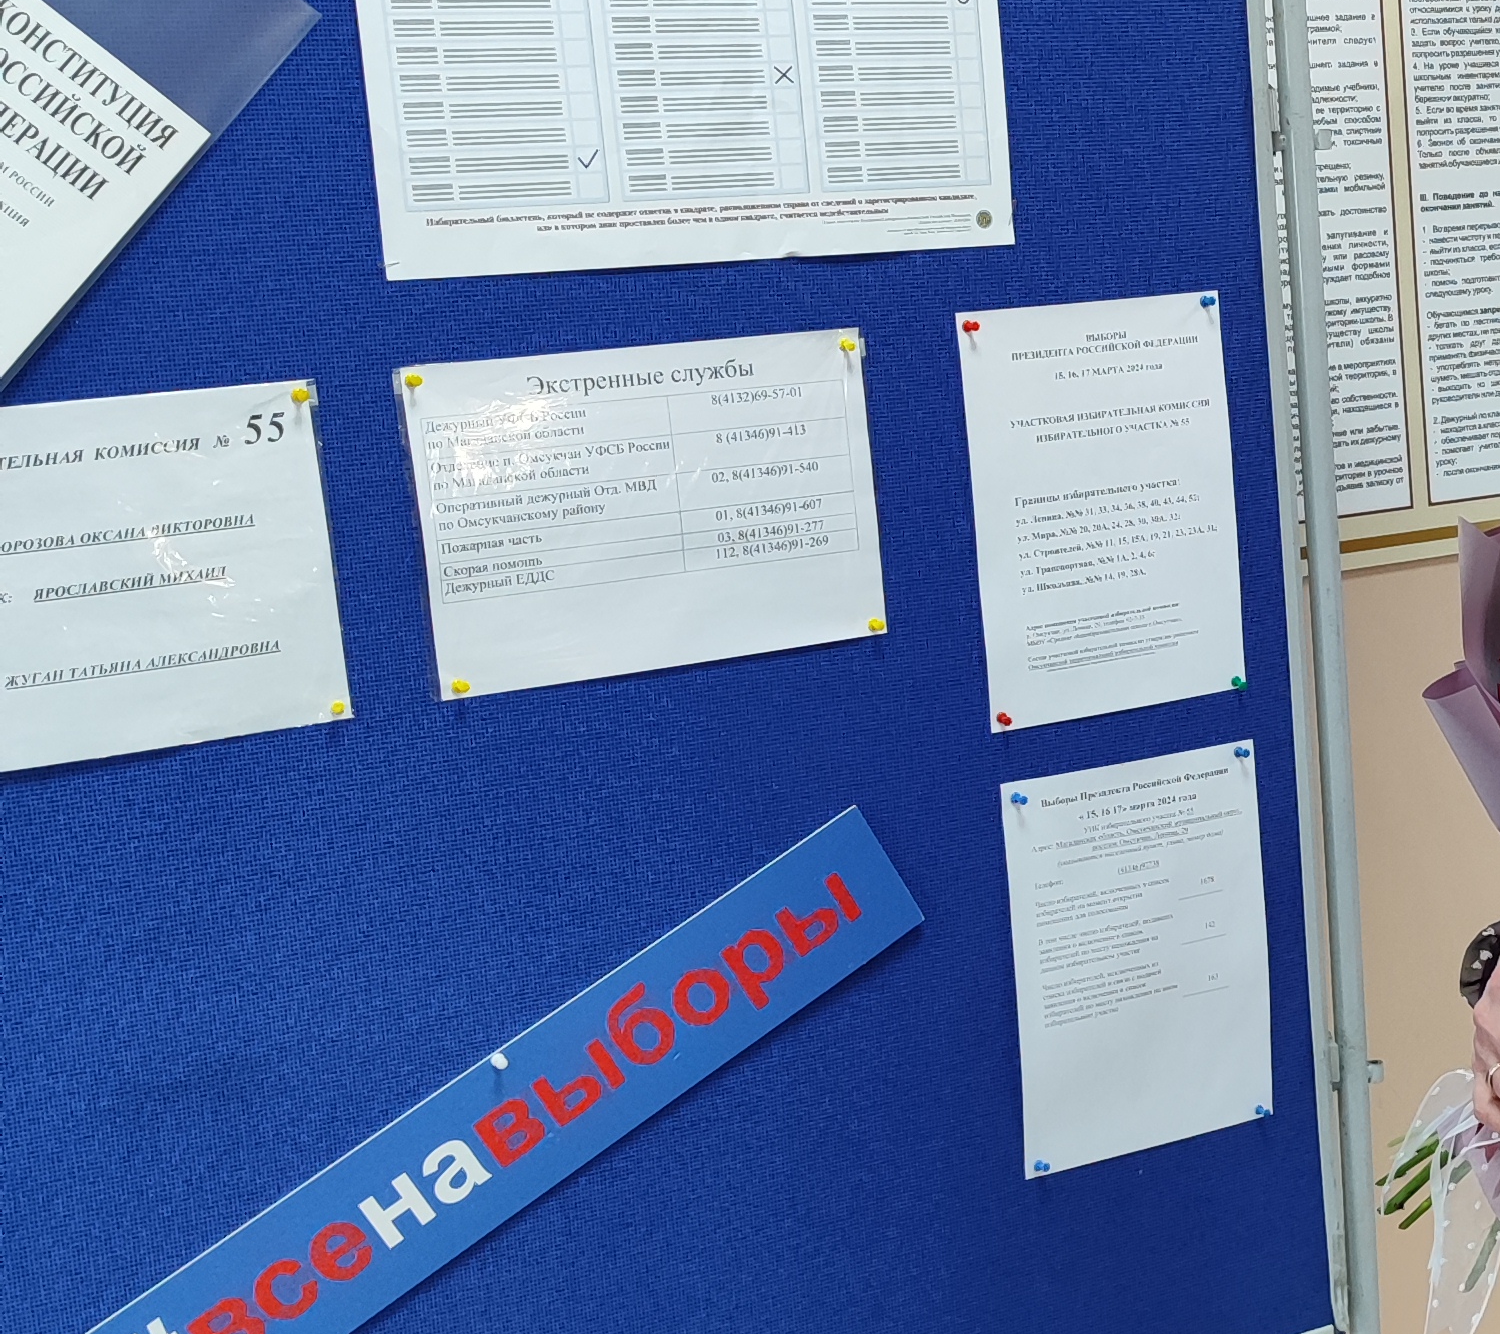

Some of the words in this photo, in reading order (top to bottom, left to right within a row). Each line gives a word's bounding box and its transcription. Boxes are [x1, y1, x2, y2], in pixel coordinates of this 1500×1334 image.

[7, 169, 56, 208] РОССИИ
[1076, 339, 1141, 354] РОССИЙСКОЙ
[526, 370, 664, 396] Экстренные
[670, 358, 754, 386] службы
[1091, 365, 1124, 376] МАРТА
[710, 386, 801, 406] 8(4132)69-57-01
[244, 411, 284, 444] 55
[1010, 413, 1074, 428] УЧАСТКОВАЯ
[425, 437, 445, 454] по
[531, 425, 584, 439] области
[725, 423, 806, 445] (41346)91-413
[94, 437, 200, 460] КОМИССИЯ
[212, 434, 229, 448] №
[584, 442, 624, 457] УФСБ
[627, 437, 673, 453] России
[539, 465, 589, 478] области
[711, 471, 729, 483] 02,
[435, 494, 522, 514] Оперативный
[526, 486, 590, 505] дежурный
[593, 485, 621, 495] Отд.
[624, 478, 657, 493] МВД
[438, 521, 454, 531] по
[457, 508, 558, 528] Омсукчанскому
[562, 503, 605, 519] району
[715, 509, 733, 521] 01,
[735, 497, 821, 519] 8(41346)91-607
[0, 534, 75, 552] ОРОЗОВА
[80, 526, 145, 543] ОКСАНА
[717, 531, 736, 543] 03,
[736, 519, 826, 543] 8(41346)91-277
[440, 539, 504, 554] Пожарная
[507, 534, 542, 545] часть
[716, 546, 739, 559] 112,
[742, 534, 828, 557] 8(41346)91-269
[441, 562, 488, 580] Скорая
[492, 557, 545, 571] помощь
[33, 572, 157, 603] ЯРОСЛАВСКИЙ
[156, 565, 226, 587] МИХАИЛ
[444, 575, 512, 595] Дежурный
[515, 569, 554, 586] ЕДДС
[4, 669, 66, 690] ЖУГАН
[65, 659, 145, 682] ТАТЬЯНА
[144, 639, 281, 671] АЛЕКСАНДРОВНА
